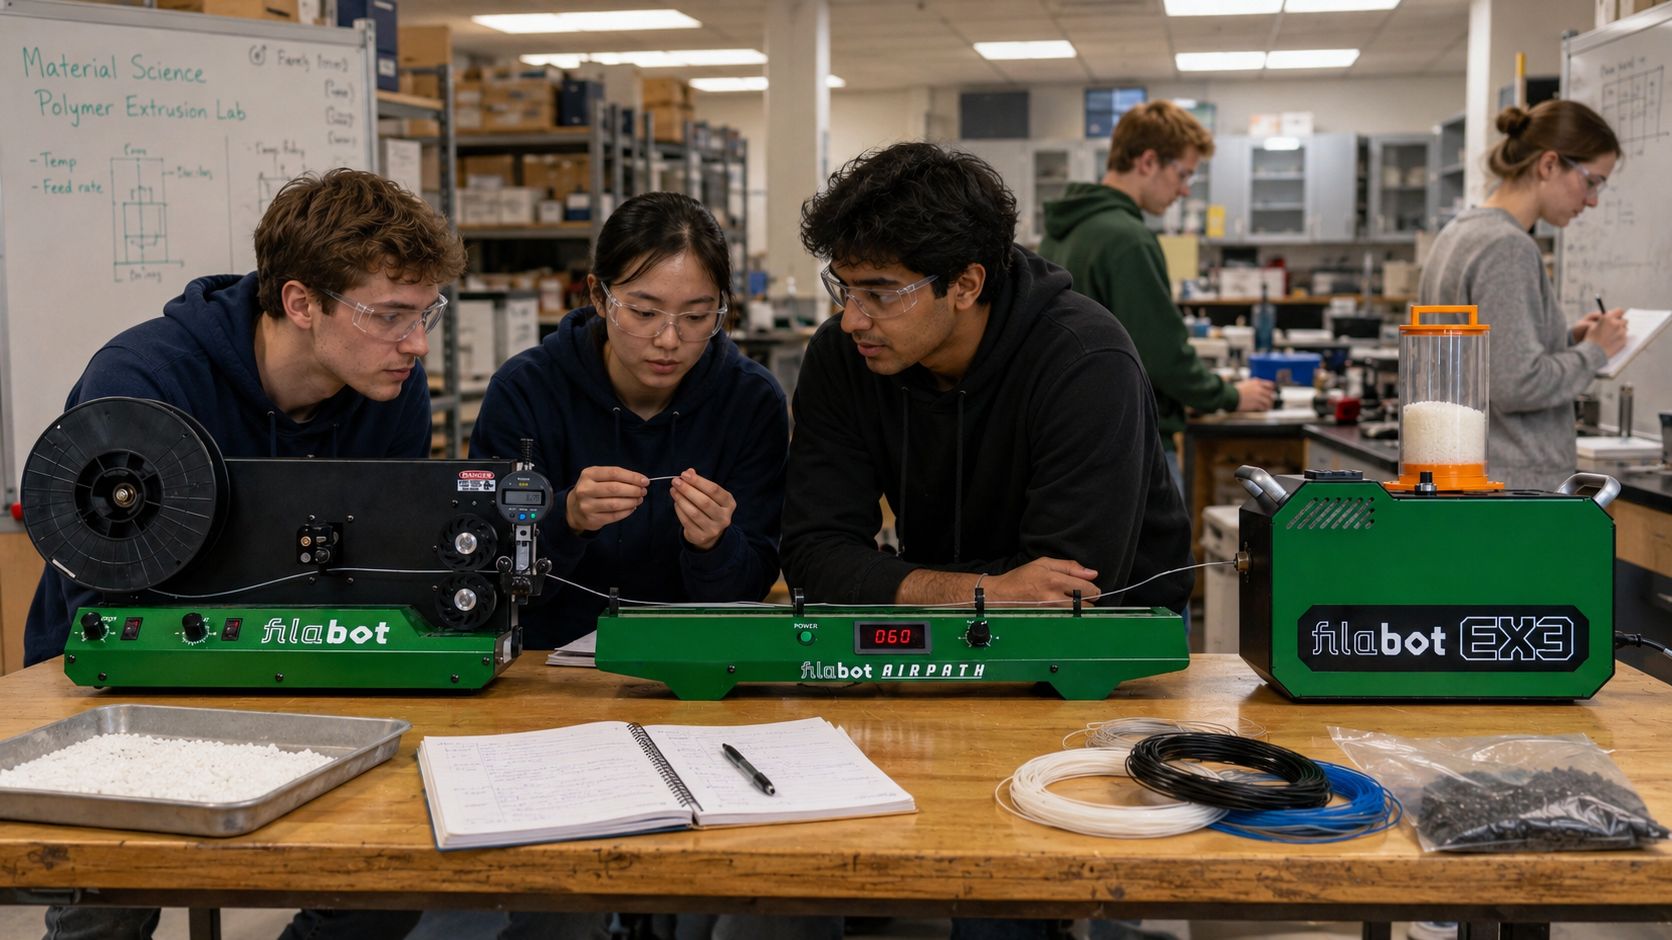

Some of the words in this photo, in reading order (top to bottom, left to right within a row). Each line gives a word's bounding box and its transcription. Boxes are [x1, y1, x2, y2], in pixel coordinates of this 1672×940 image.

[22, 47, 117, 80] Material
[131, 54, 207, 84] Science
[34, 89, 113, 127] Polymer
[126, 95, 207, 120] Extrusion
[216, 99, 247, 121] Lab
[40, 152, 77, 172] Temp
[43, 179, 72, 194] Feed
[78, 181, 104, 194] rate
[261, 617, 390, 645] filabot
[875, 629, 911, 645] 060
[1312, 621, 1447, 657] filabot
[1460, 616, 1575, 661] EX3
[800, 661, 872, 679] filabot
[881, 664, 985, 679] AIRPATH
